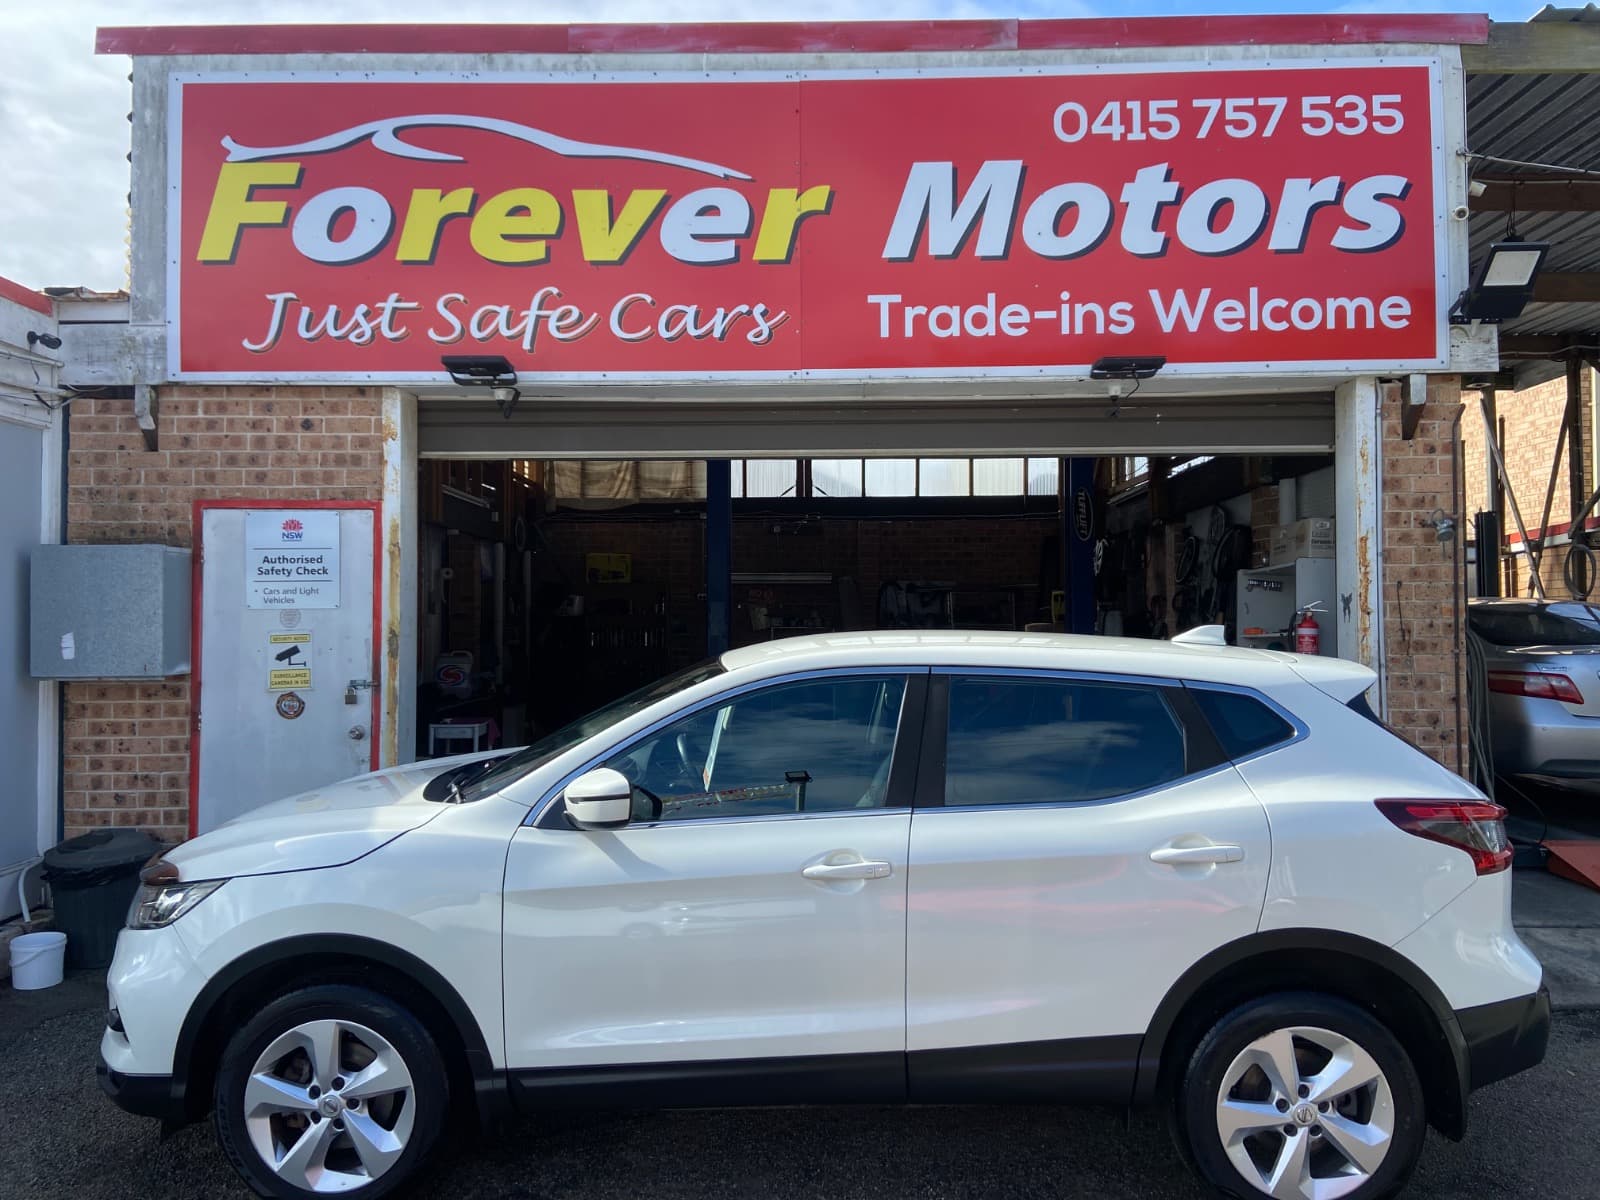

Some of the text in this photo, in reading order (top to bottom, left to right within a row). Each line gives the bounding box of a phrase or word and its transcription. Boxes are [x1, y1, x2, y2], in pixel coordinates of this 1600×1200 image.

[1053, 94, 1405, 143] 0415 757 535
[197, 161, 834, 266] Forever
[882, 159, 1412, 262] Motors
[241, 285, 790, 353] Just Safe Cars
[867, 286, 1412, 339] Trade-ins Welcome
[262, 555, 323, 564] Authorised
[282, 531, 303, 539] NSW
[257, 566, 329, 577] Safety Check
[263, 587, 319, 596] Cars and Light
